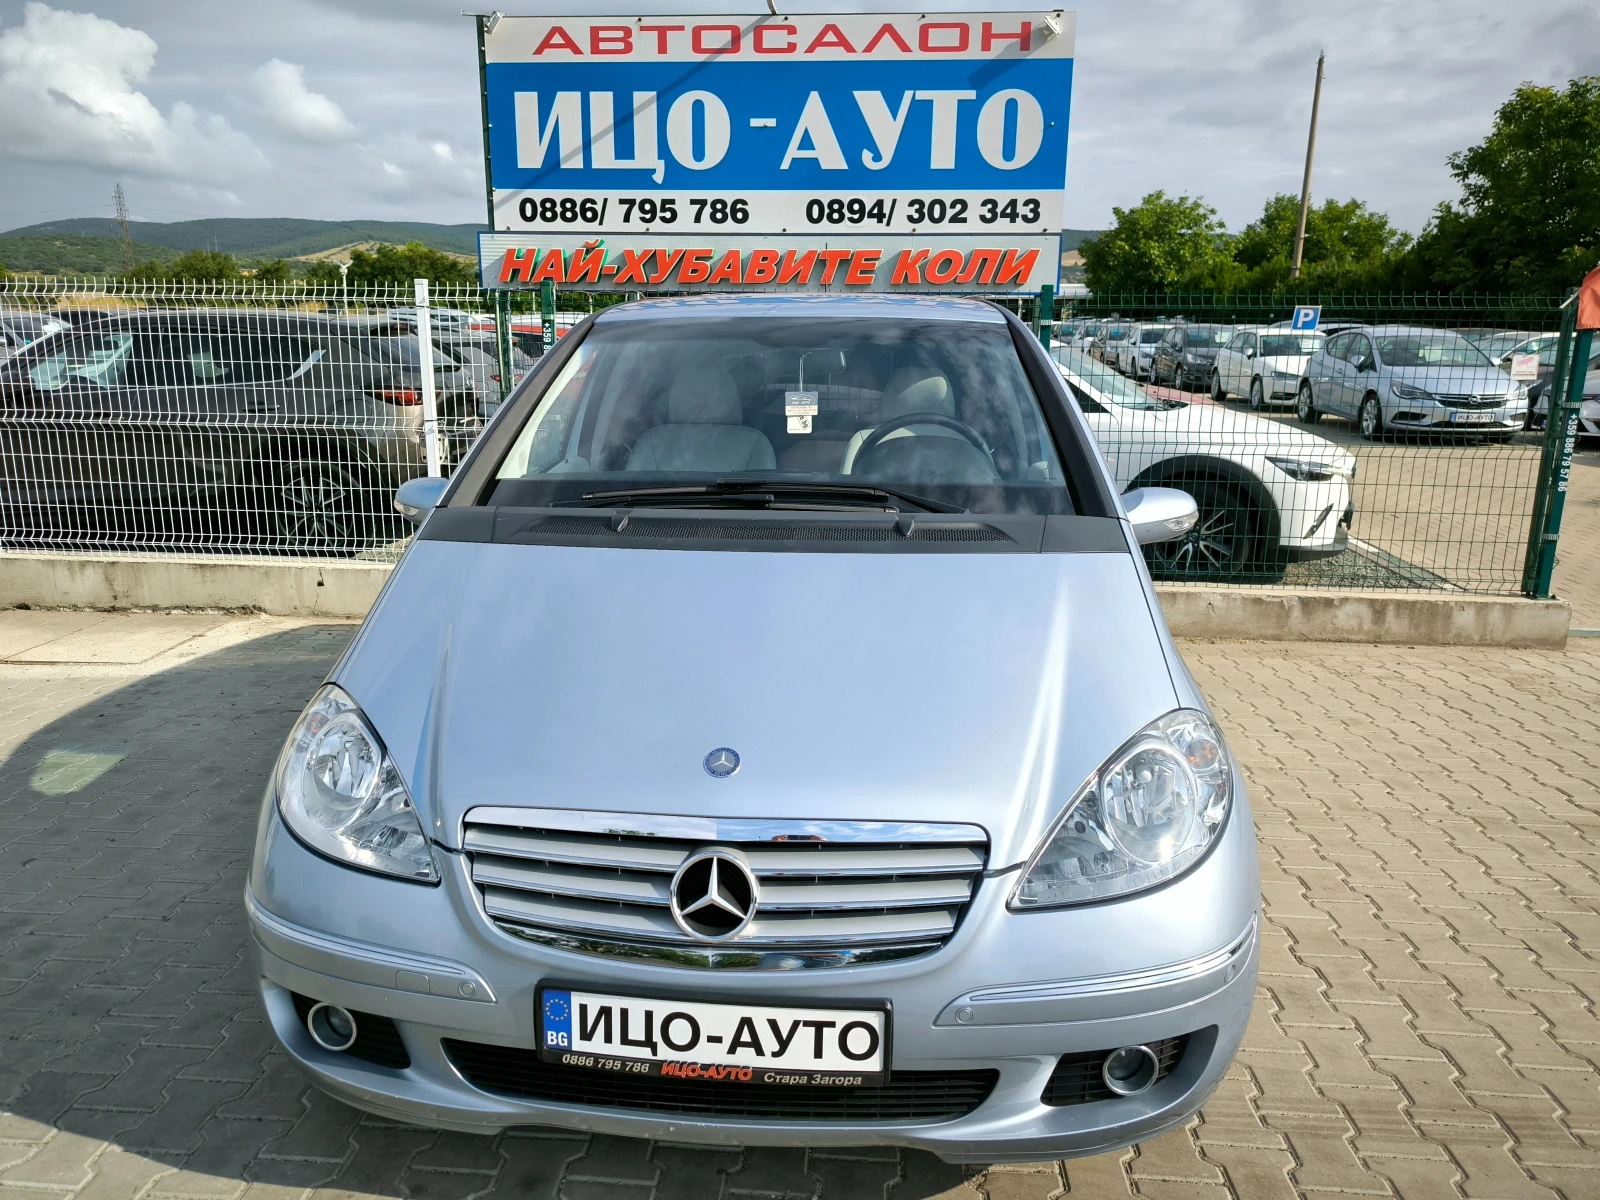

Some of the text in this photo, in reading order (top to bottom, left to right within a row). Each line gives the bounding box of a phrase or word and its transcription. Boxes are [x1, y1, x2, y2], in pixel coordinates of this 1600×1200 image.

[533, 22, 1032, 55] АВТОСАЛОН
[518, 198, 750, 226] 0886/ 795 786
[805, 199, 1041, 227] 0894/ 302 343
[498, 239, 1042, 287] НАЙ-ХУБАВИТЕ КОЛИ
[1297, 309, 1315, 328] P
[543, 322, 552, 343] +359
[1557, 414, 1578, 492] +359 886 79 57 86
[547, 1031, 568, 1047] BG
[578, 1003, 880, 1062] ИЦО-АУТО
[562, 1054, 650, 1073] 0886 795 786
[660, 1061, 753, 1081] ИЦО-АУТО
[764, 1072, 862, 1088] Стара Загора
